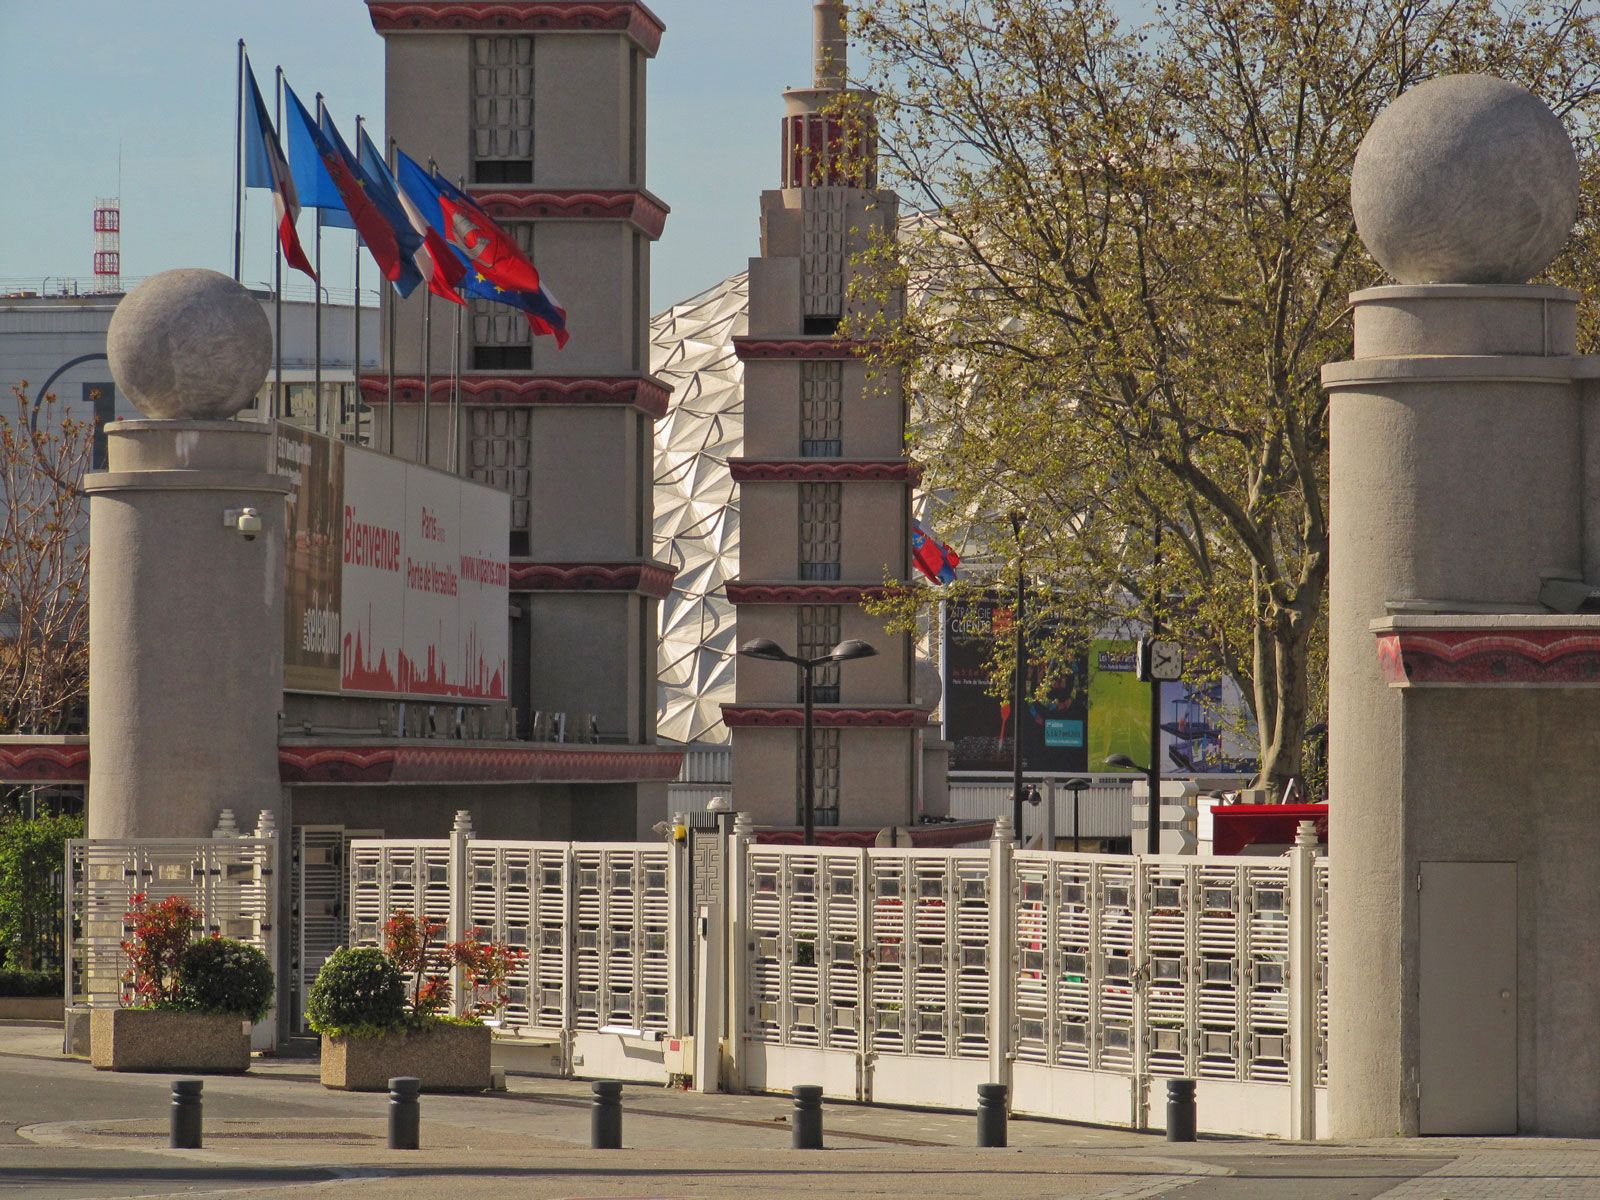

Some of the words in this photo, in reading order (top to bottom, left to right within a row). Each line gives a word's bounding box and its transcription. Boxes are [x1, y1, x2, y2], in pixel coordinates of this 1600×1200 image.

[344, 505, 400, 572] Bienvenue
[421, 506, 437, 540] Paris
[407, 557, 423, 590] Porte
[424, 560, 431, 593] de
[432, 560, 457, 597] Versailles
[460, 549, 507, 591] www.viparis.com
[306, 589, 340, 655] sélection
